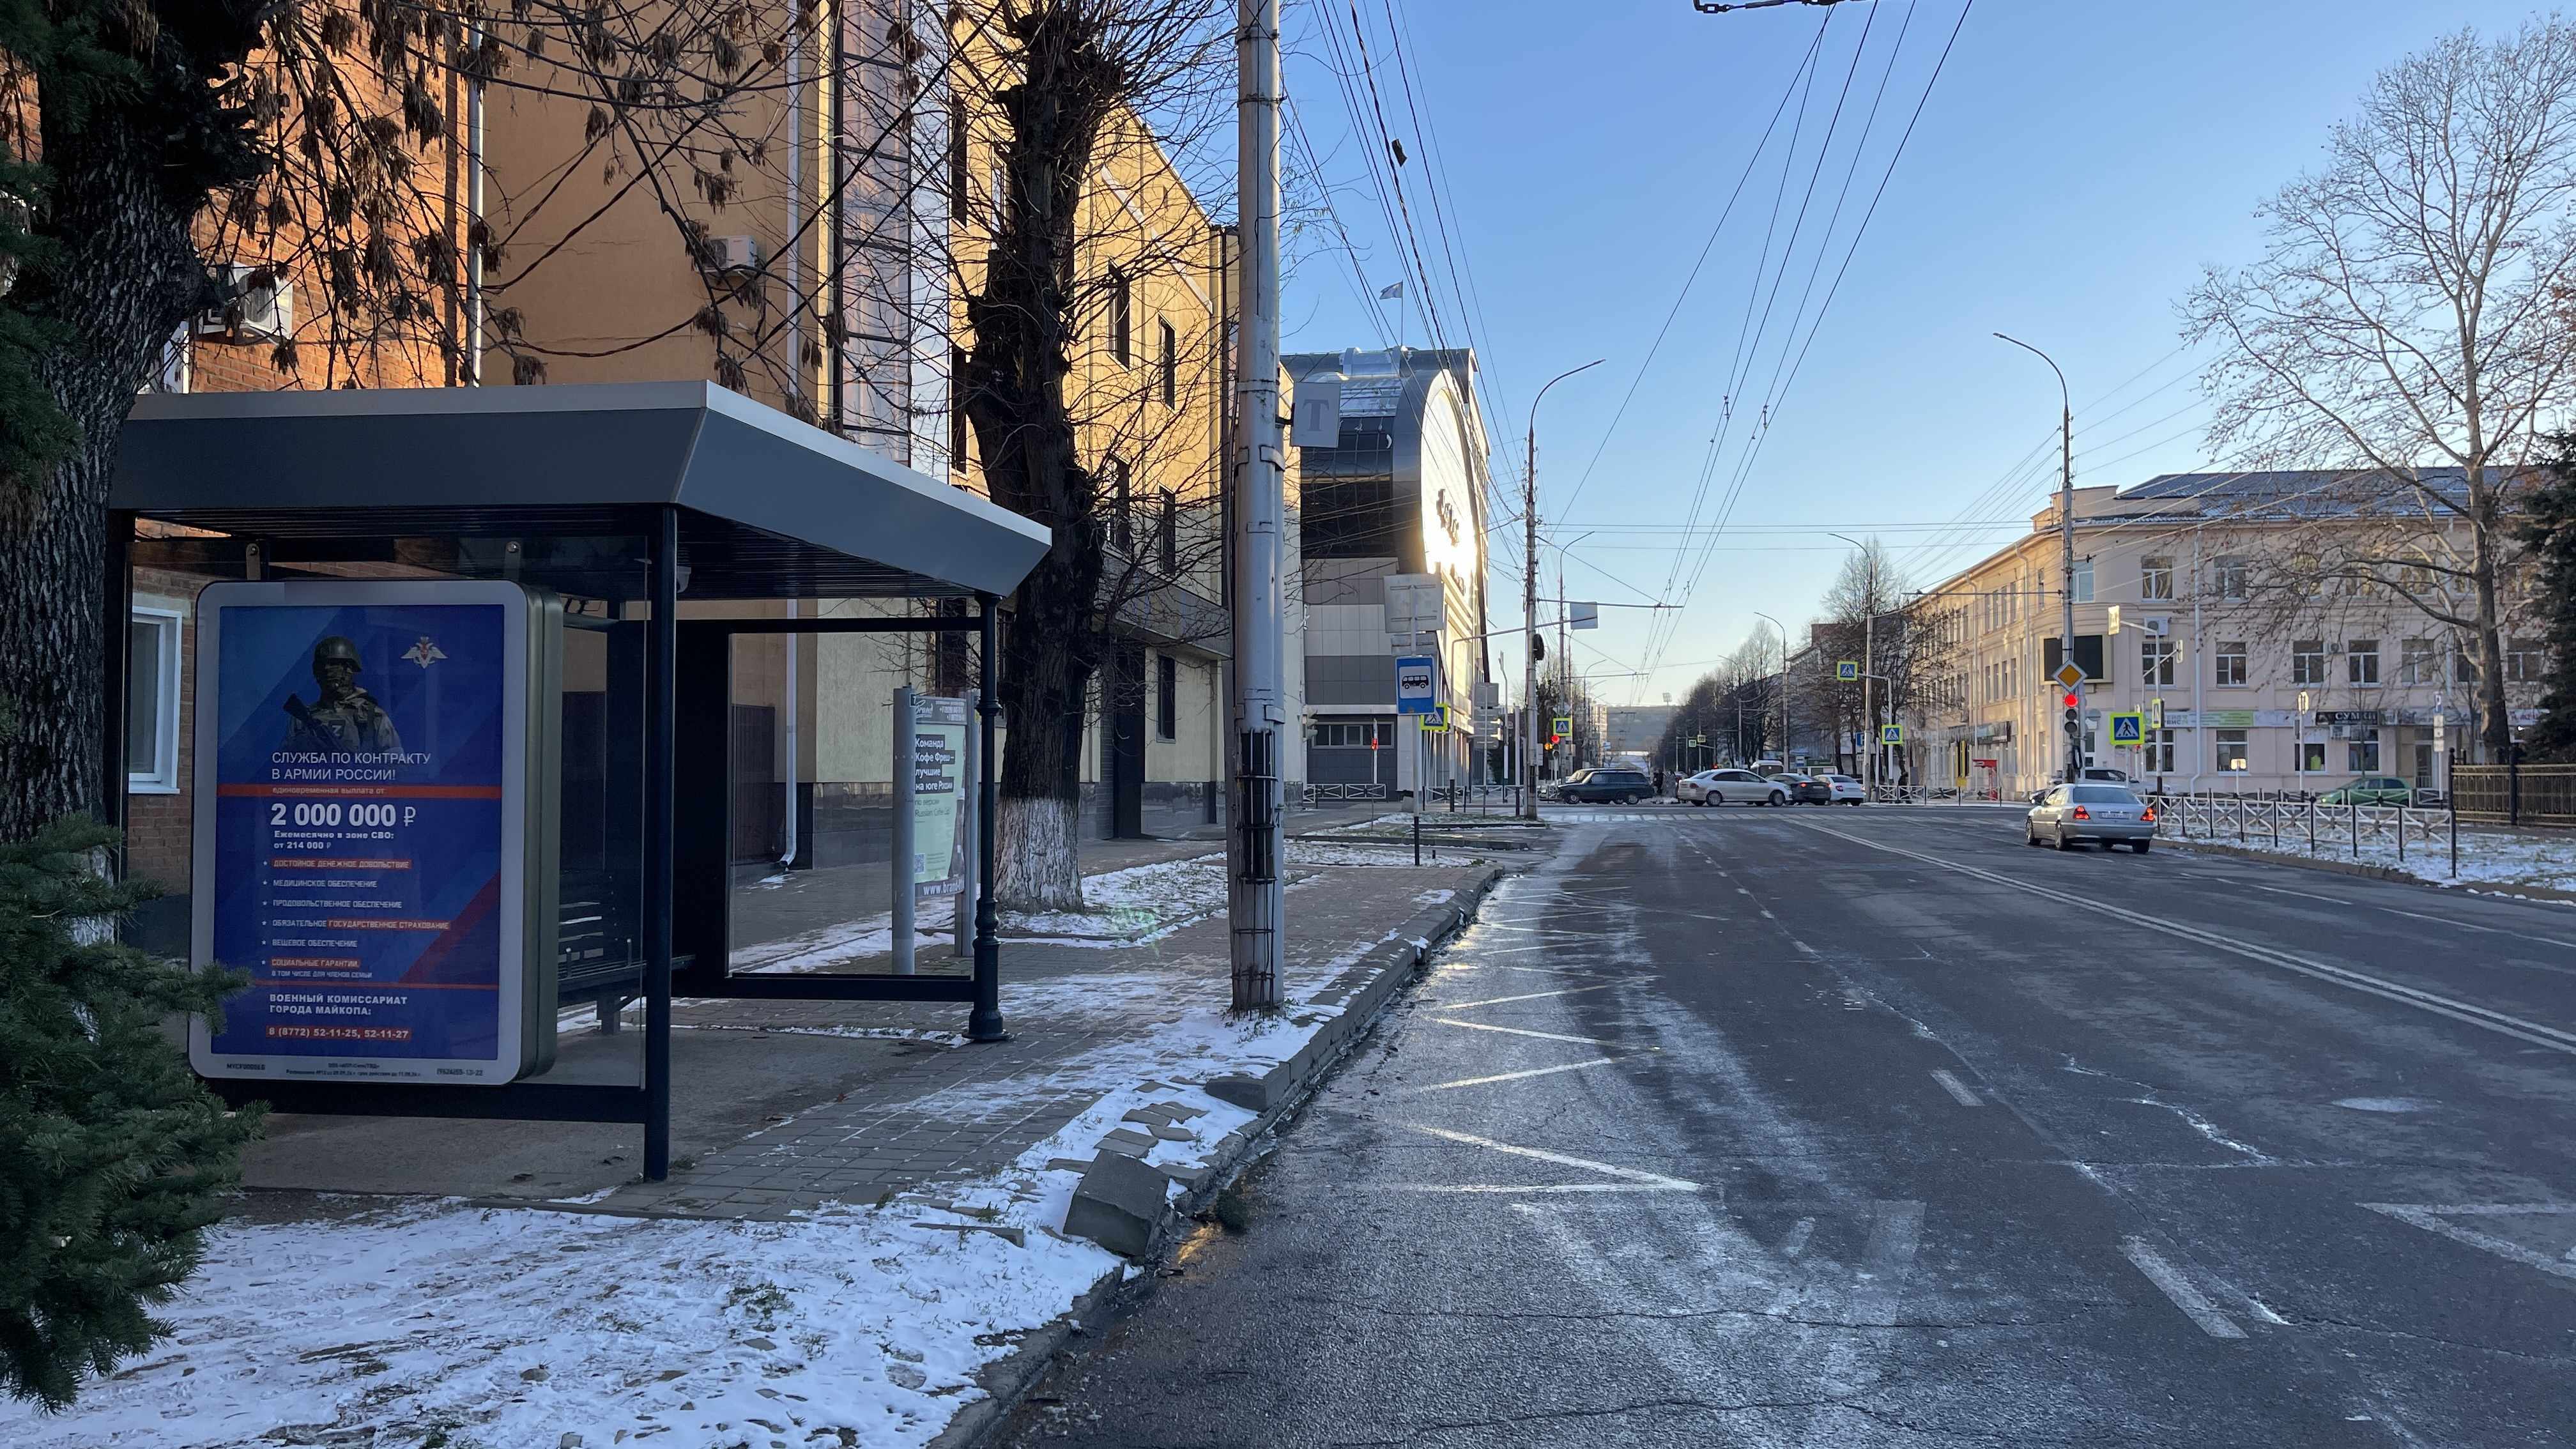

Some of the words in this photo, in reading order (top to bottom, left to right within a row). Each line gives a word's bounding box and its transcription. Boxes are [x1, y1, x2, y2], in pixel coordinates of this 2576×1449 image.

[915, 738, 944, 749] Команда
[272, 752, 327, 763] СЛУЖБА
[332, 753, 350, 763] ПО
[355, 753, 431, 764] КОНТРАКТУ
[915, 753, 933, 763] Кофе
[272, 769, 280, 779] В
[284, 769, 331, 779] АРМИИ
[335, 769, 395, 780] РОССИИ!
[916, 769, 940, 778] лучшие
[271, 803, 286, 825] 2
[295, 803, 341, 826] 000
[349, 804, 396, 827] 000
[273, 900, 351, 908] ПРОДОВОЛЬСТВЕННОЕ
[270, 993, 323, 1002] ВОЕННЫЙ
[327, 995, 408, 1004] КОМИССАРИАТ
[270, 1005, 312, 1015] ГОРОДА
[316, 1005, 371, 1015] МАЙКОПА:
[279, 1027, 310, 1038] (8772)
[314, 1028, 360, 1038] 52-11-25,
[364, 1030, 409, 1038] 52-11-27
